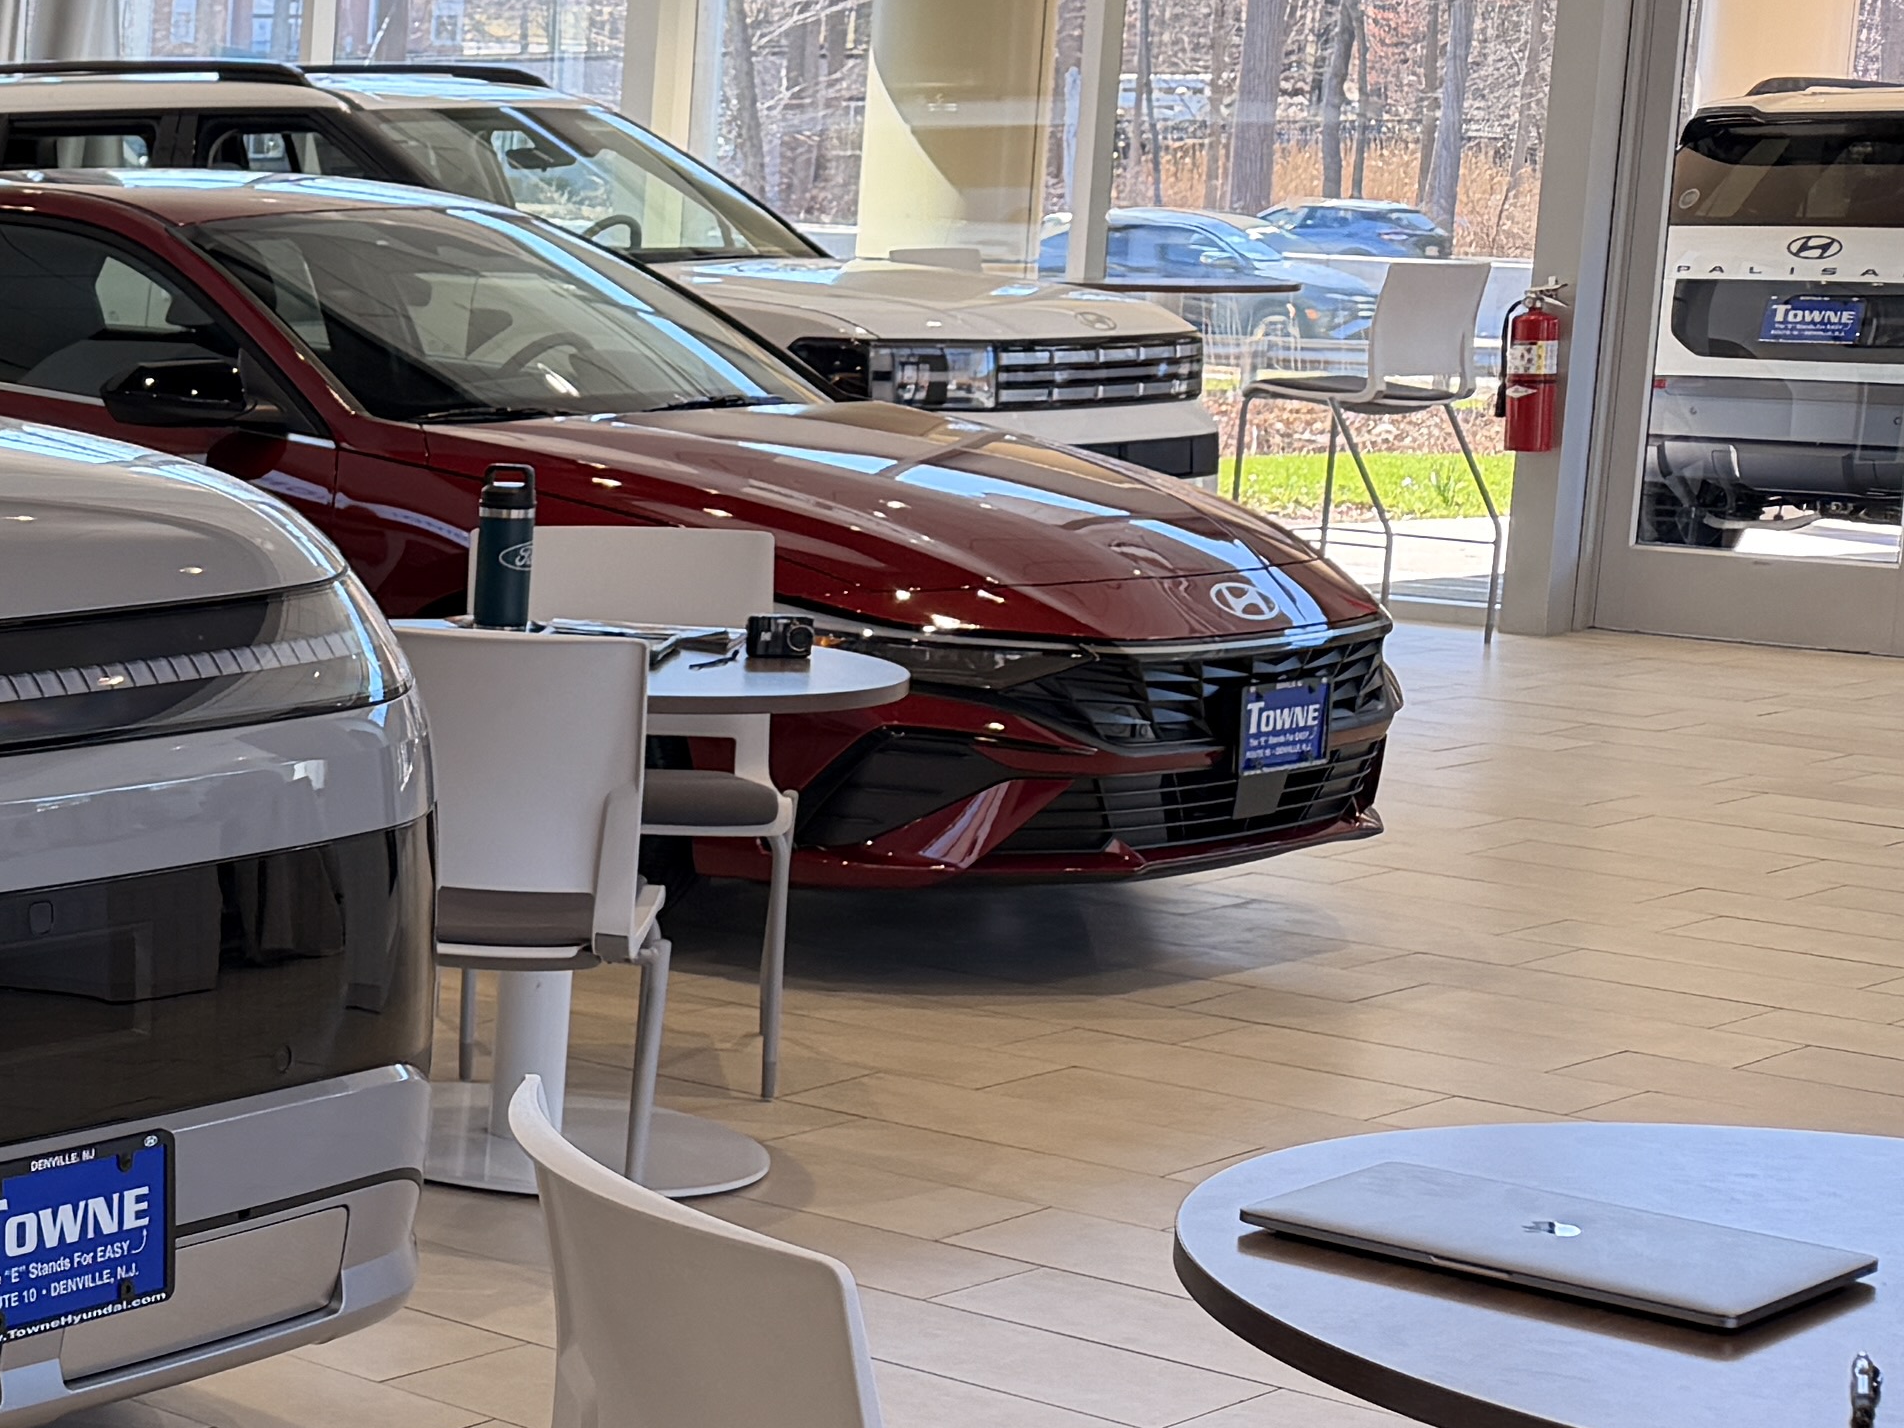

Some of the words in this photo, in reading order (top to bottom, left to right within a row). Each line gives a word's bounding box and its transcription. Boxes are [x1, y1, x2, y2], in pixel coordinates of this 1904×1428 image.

[1677, 265, 1904, 277] PALISA
[1772, 304, 1855, 323] TOWNE
[1247, 701, 1320, 734] TOWNE
[28, 1256, 71, 1279] Stands
[73, 1252, 94, 1268] For
[96, 1239, 130, 1262] EASY
[22, 1287, 37, 1303] 10
[50, 1270, 114, 1297] DENVILLE,
[117, 1262, 140, 1281] N.J.
